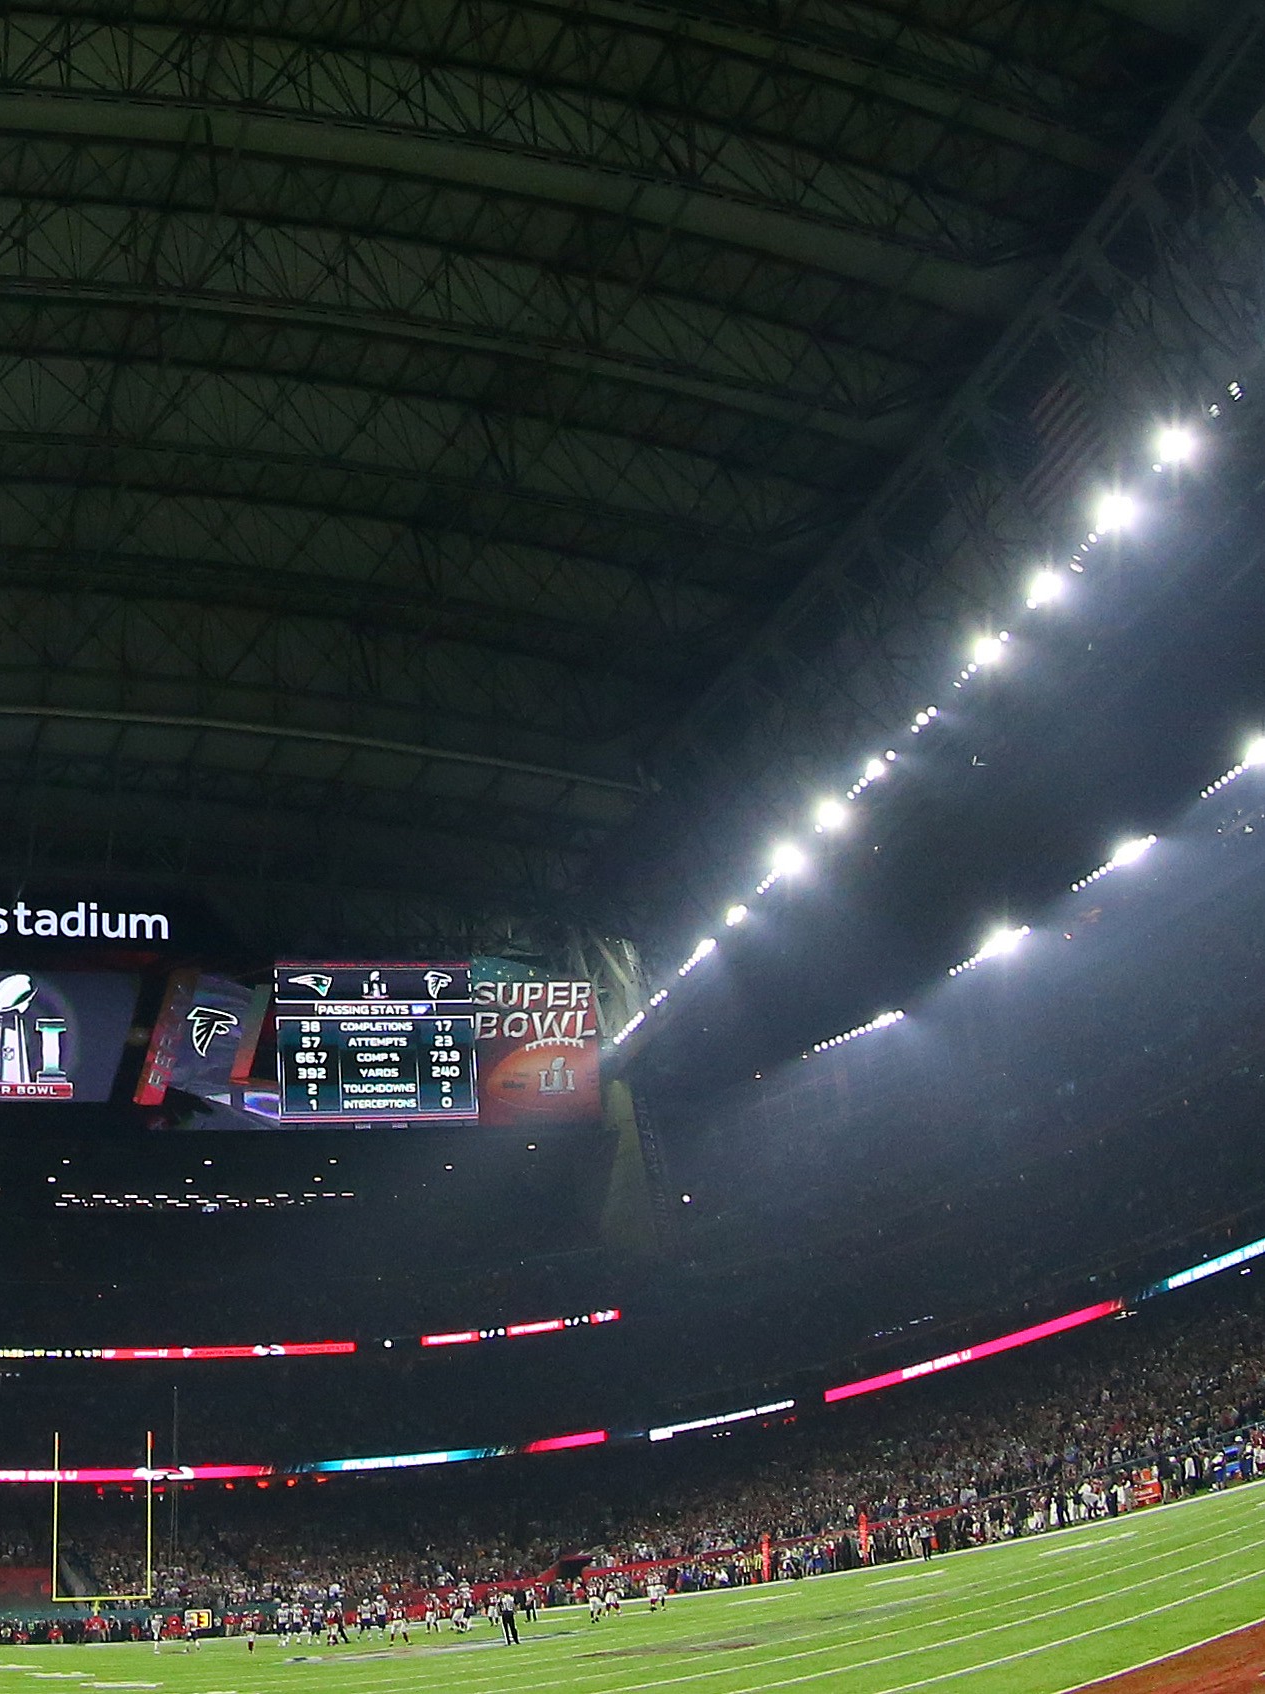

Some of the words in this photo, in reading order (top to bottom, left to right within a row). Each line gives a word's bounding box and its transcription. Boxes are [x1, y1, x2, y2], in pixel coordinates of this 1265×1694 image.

[473, 981, 592, 1010] SUPER
[317, 1005, 370, 1016] PASSING
[371, 1004, 409, 1015] STATS
[300, 1020, 321, 1033] 38
[339, 1021, 414, 1032] COMPLETIONS
[435, 1020, 453, 1032] 17
[475, 1010, 597, 1040] BOWL
[301, 1036, 321, 1048] 57
[348, 1037, 408, 1047] ATTEMPTS
[434, 1035, 454, 1047] 23
[295, 1051, 328, 1064] 66.7
[356, 1052, 388, 1063] COMP
[429, 1050, 461, 1063] 73.9
[297, 1067, 327, 1080] 392
[359, 1068, 399, 1078] YARDS
[431, 1065, 460, 1078] 240
[16, 1085, 57, 1095] BOWL
[307, 1083, 318, 1095] 2
[343, 1083, 416, 1094] TOUCHDOWNS
[441, 1081, 451, 1093] 2
[309, 1099, 318, 1111] 1
[343, 1099, 417, 1109] INTERCEPTIONS
[441, 1097, 453, 1108] 0
